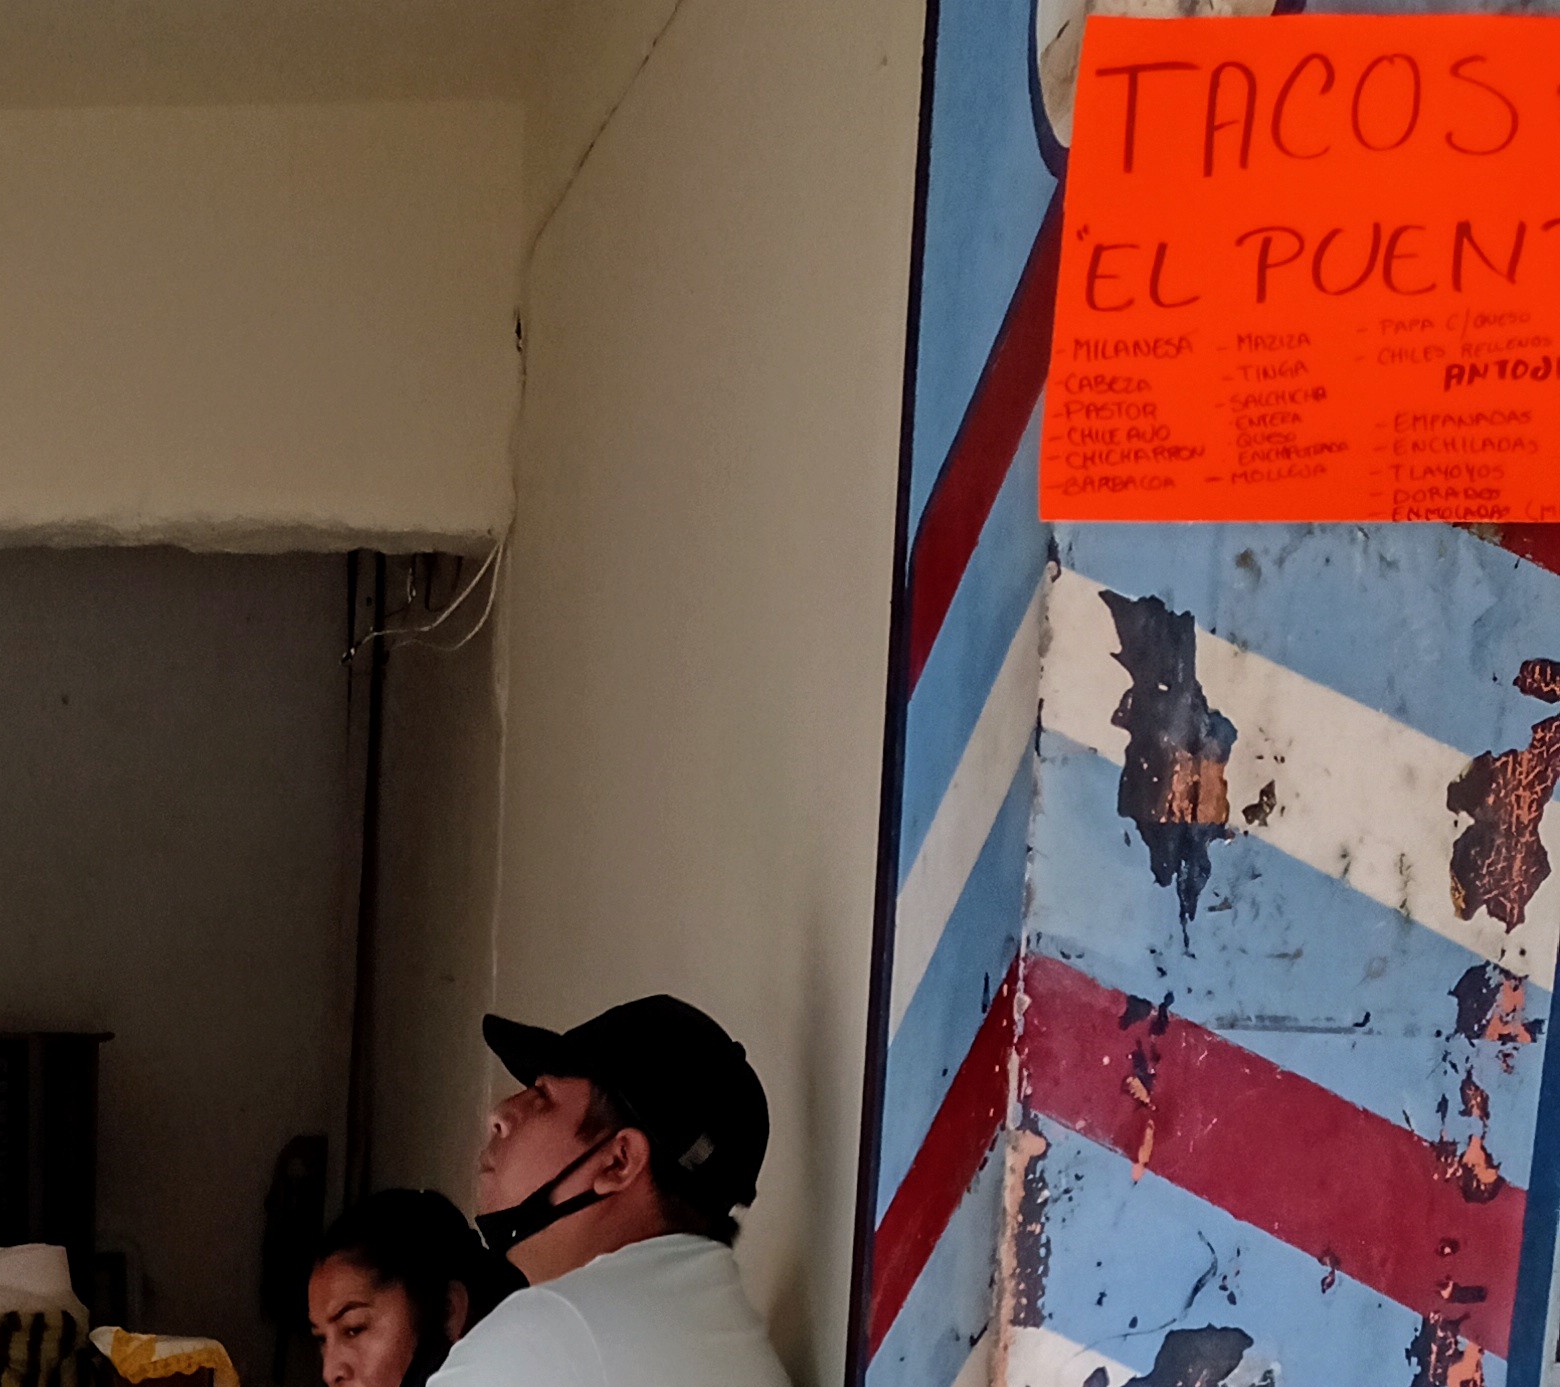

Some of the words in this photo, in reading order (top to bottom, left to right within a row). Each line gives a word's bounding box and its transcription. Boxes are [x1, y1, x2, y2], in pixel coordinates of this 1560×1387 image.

[1095, 52, 1519, 178] TACOS
[1379, 317, 1435, 336] PAPA
[1073, 336, 1194, 363] MILANESA
[1236, 332, 1311, 353] MAZIZA
[1377, 346, 1446, 366] CHILES
[1461, 335, 1553, 359] RELLENOS
[1237, 359, 1310, 383] TINGA
[1064, 372, 1153, 395] CABEZA
[1063, 400, 1157, 421] PASTOR
[1229, 386, 1328, 412] SALCHICHA
[1394, 409, 1533, 434] EMPANADAS
[1067, 426, 1122, 446] CHILE
[1126, 424, 1171, 443] AJO
[1392, 437, 1539, 456] ENCHILADAS
[1065, 445, 1205, 470] CHICHARRON
[1230, 462, 1327, 485] MOLLEJA
[1390, 463, 1505, 484] TLAYOYOS
[1062, 474, 1176, 497] BARBACOA
